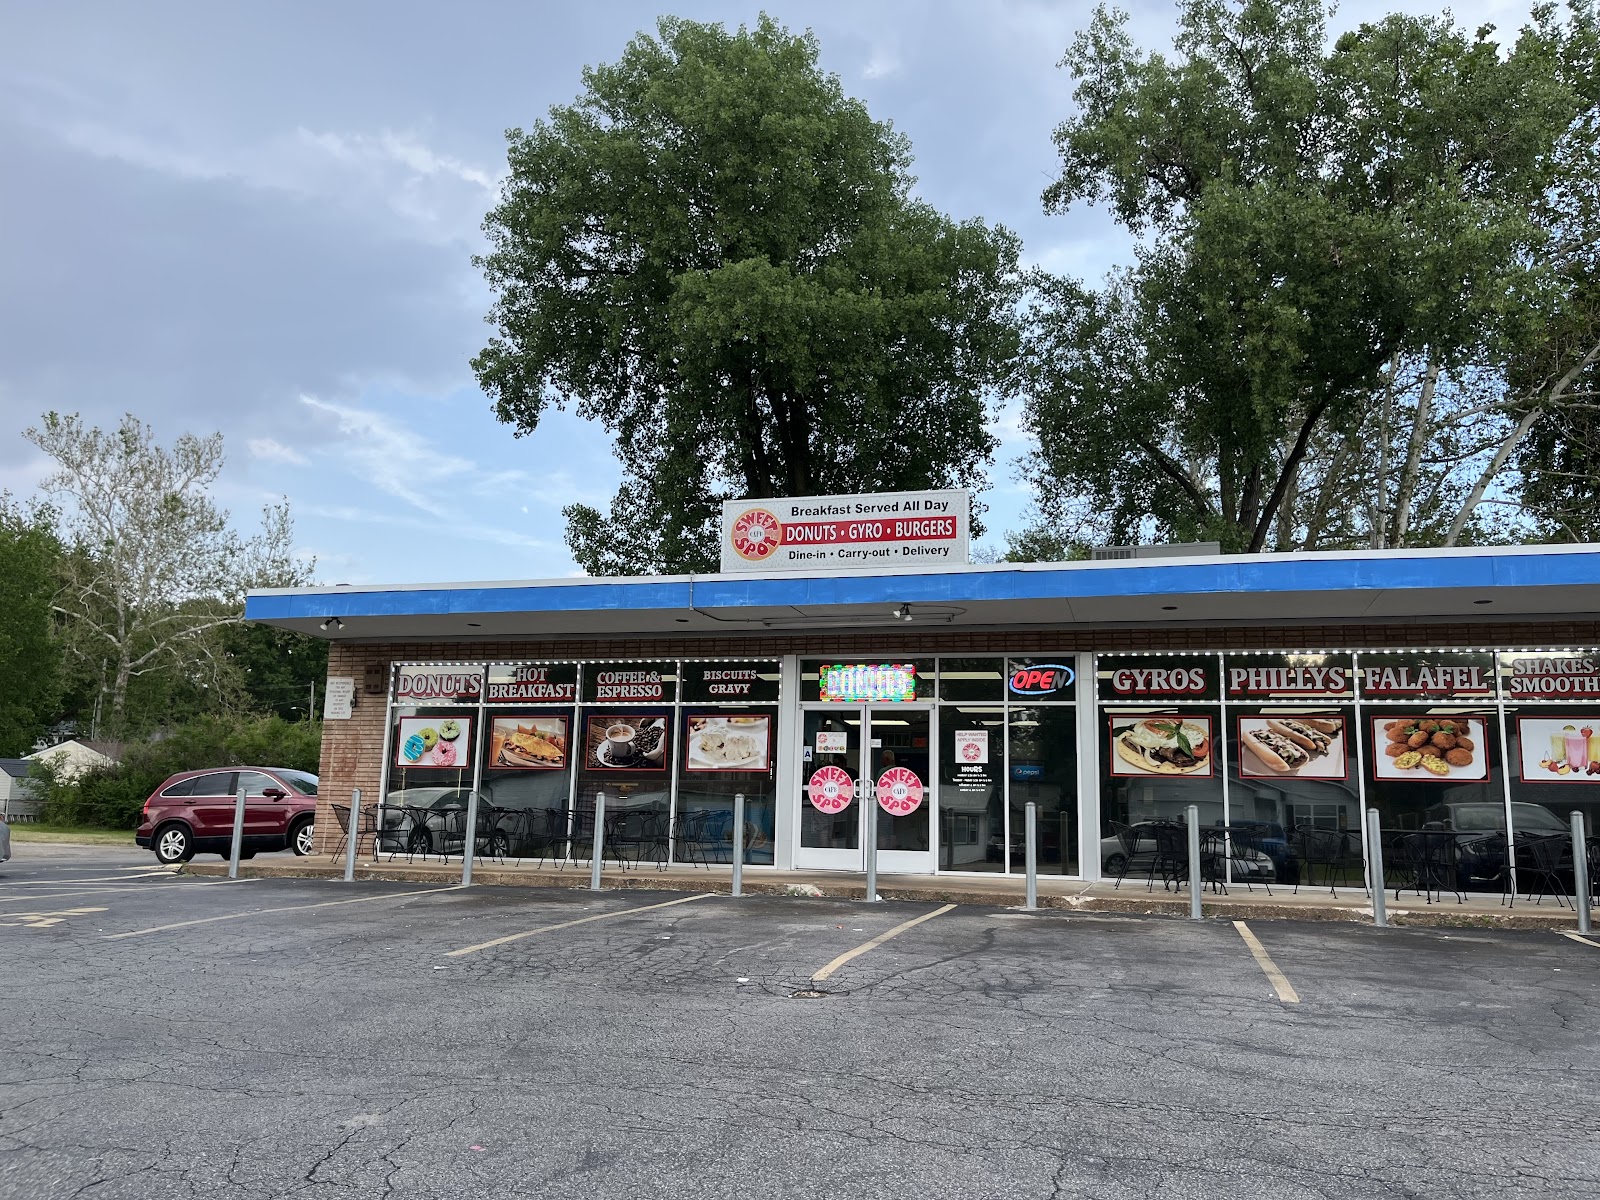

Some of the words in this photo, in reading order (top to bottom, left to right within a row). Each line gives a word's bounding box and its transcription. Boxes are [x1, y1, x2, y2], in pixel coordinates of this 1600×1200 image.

[791, 504, 851, 517] Breakfast
[855, 502, 899, 514] Served
[903, 500, 920, 511] All
[924, 499, 949, 512] Day
[735, 511, 779, 532] SWEET
[786, 524, 837, 542] DONUTS
[848, 522, 883, 539] GYRO
[895, 519, 953, 537] BURGERS
[734, 536, 778, 556] SPOT
[788, 550, 826, 560] Dine-in
[838, 548, 890, 560] Carry-out
[902, 545, 950, 557] Delivery
[516, 667, 548, 682] HOT
[703, 669, 757, 680] BISCUITS
[1512, 658, 1596, 676] SHAKES
[397, 673, 481, 697] DONUTS
[597, 671, 646, 684] COFFEE
[827, 670, 909, 696] DONUTS
[1013, 670, 1068, 690] OPEN
[1112, 667, 1206, 694] GYROS
[1229, 666, 1347, 693] PHILLYS
[1364, 666, 1490, 693] FALAFEL
[1510, 676, 1600, 695] SMOOTH
[488, 683, 575, 701] BREAKFAST
[596, 684, 664, 700] ESPRESSO
[708, 683, 752, 694] GRAVY
[804, 750, 811, 758] A
[811, 767, 852, 787] SWEET
[961, 765, 983, 773] HOURS
[879, 768, 922, 789] SWEET
[812, 793, 849, 809] SPOT
[880, 795, 919, 811] SPOT
